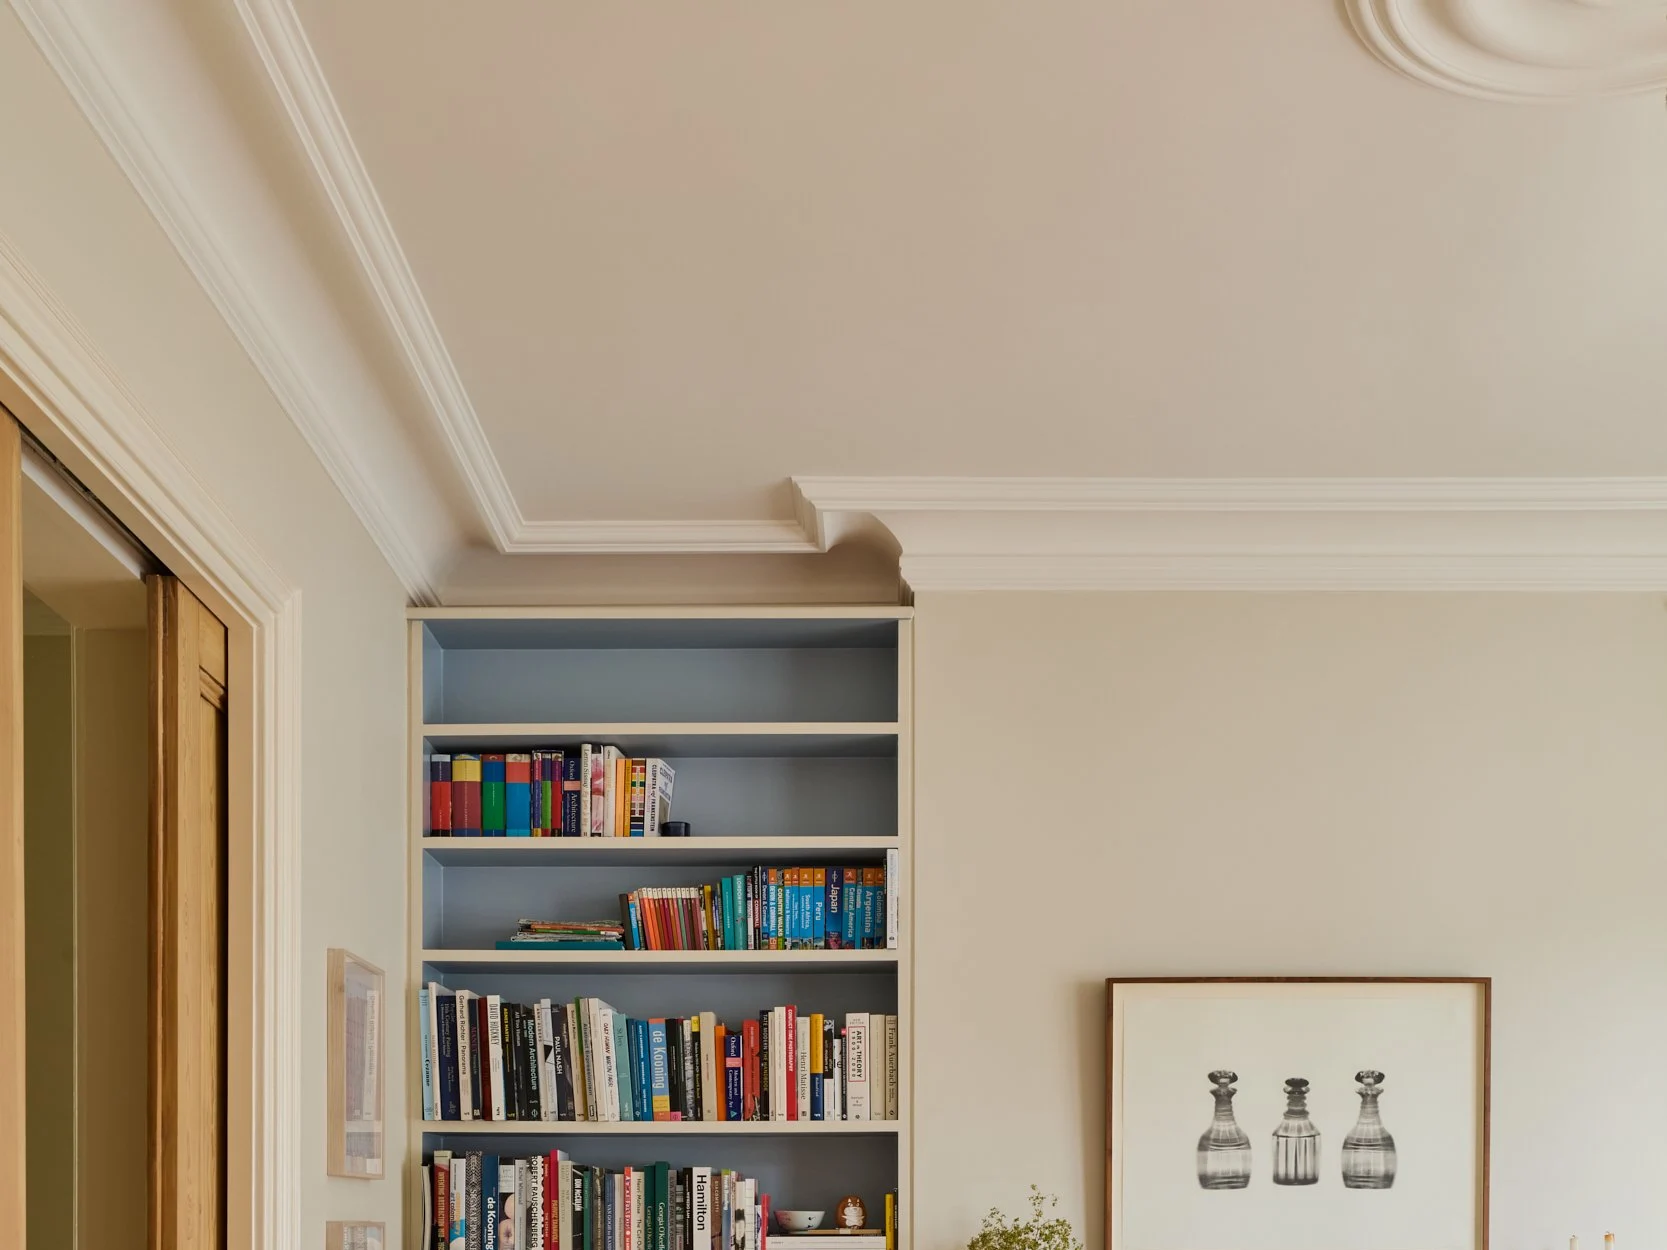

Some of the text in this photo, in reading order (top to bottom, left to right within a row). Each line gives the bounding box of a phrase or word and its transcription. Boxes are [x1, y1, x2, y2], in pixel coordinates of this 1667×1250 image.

[829, 884, 840, 913] Japan
[864, 890, 873, 933] Argentina
[489, 1004, 499, 1045] DAVID HOCKNEY
[529, 1048, 538, 1090] Architecture
[554, 1036, 563, 1074] PAUL NASH
[651, 1031, 666, 1088] de Kooning
[800, 1052, 808, 1100] Henri Matisse
[487, 1197, 496, 1208] de
[697, 1174, 707, 1230] Hamilton
[486, 1210, 496, 1250] Kooning
